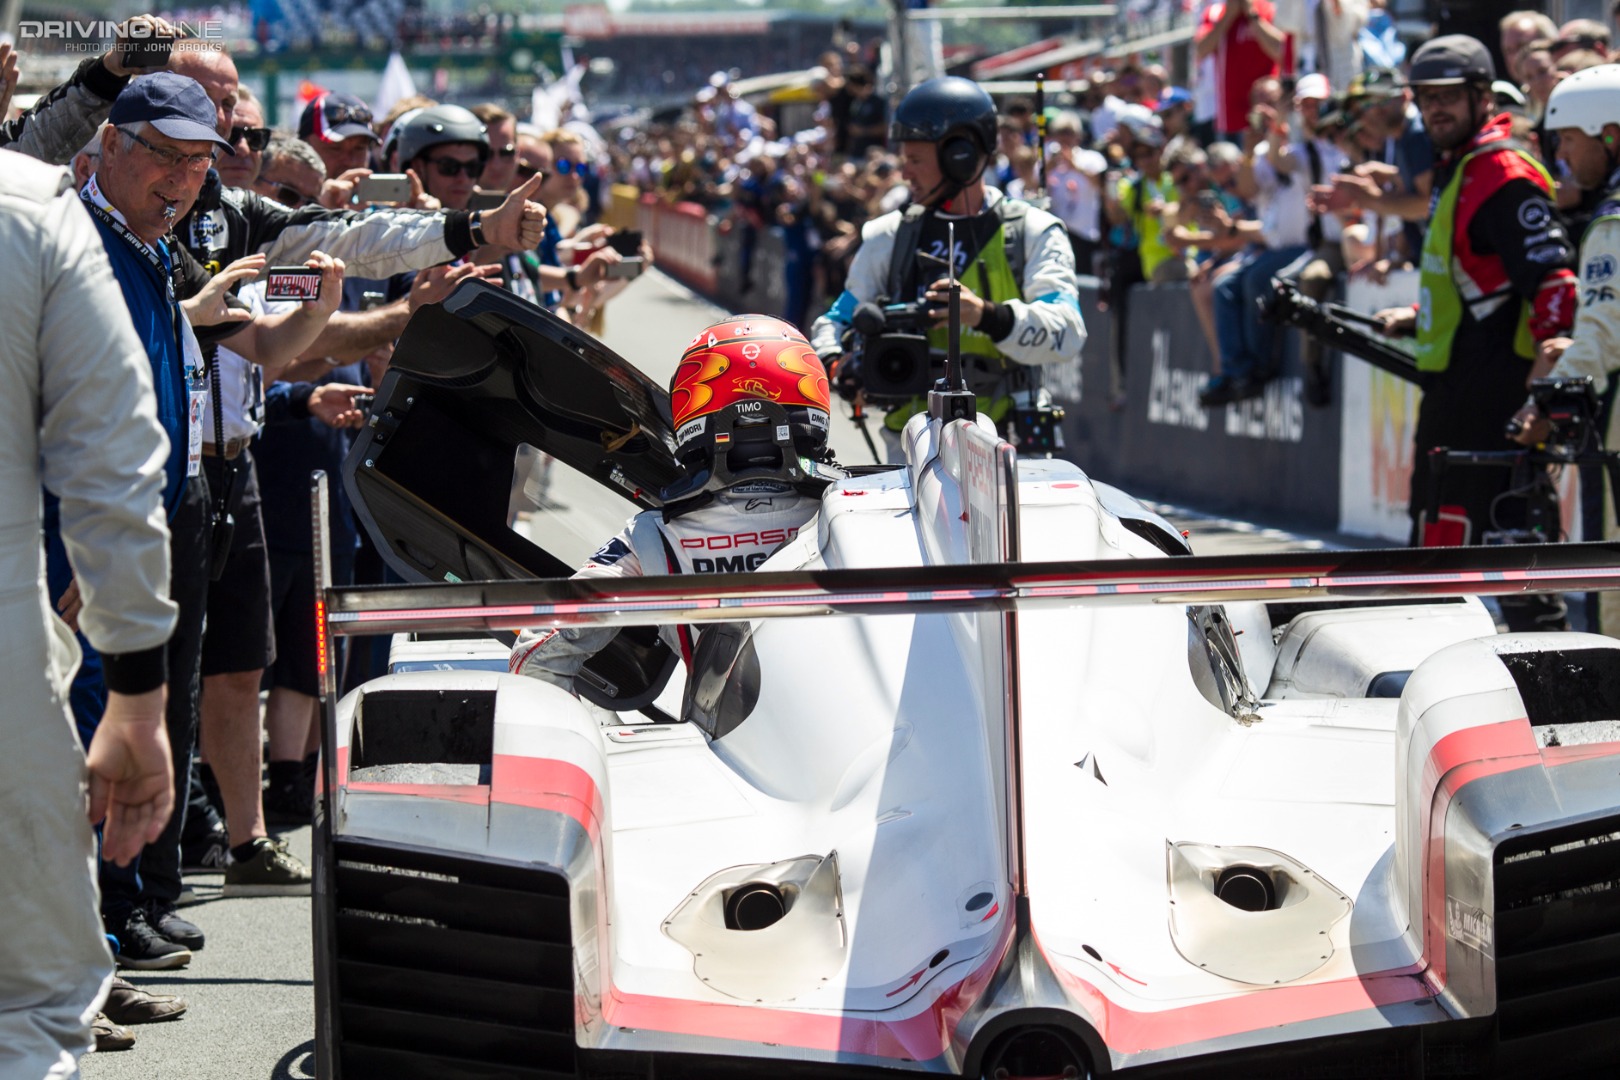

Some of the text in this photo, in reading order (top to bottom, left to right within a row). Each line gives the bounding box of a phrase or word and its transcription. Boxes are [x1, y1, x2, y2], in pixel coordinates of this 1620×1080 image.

[1585, 260, 1613, 280] FIA
[268, 275, 319, 297] MYTHIQUE
[735, 401, 762, 414] TIMO
[683, 423, 702, 437] MORI
[692, 552, 768, 574] DMG
